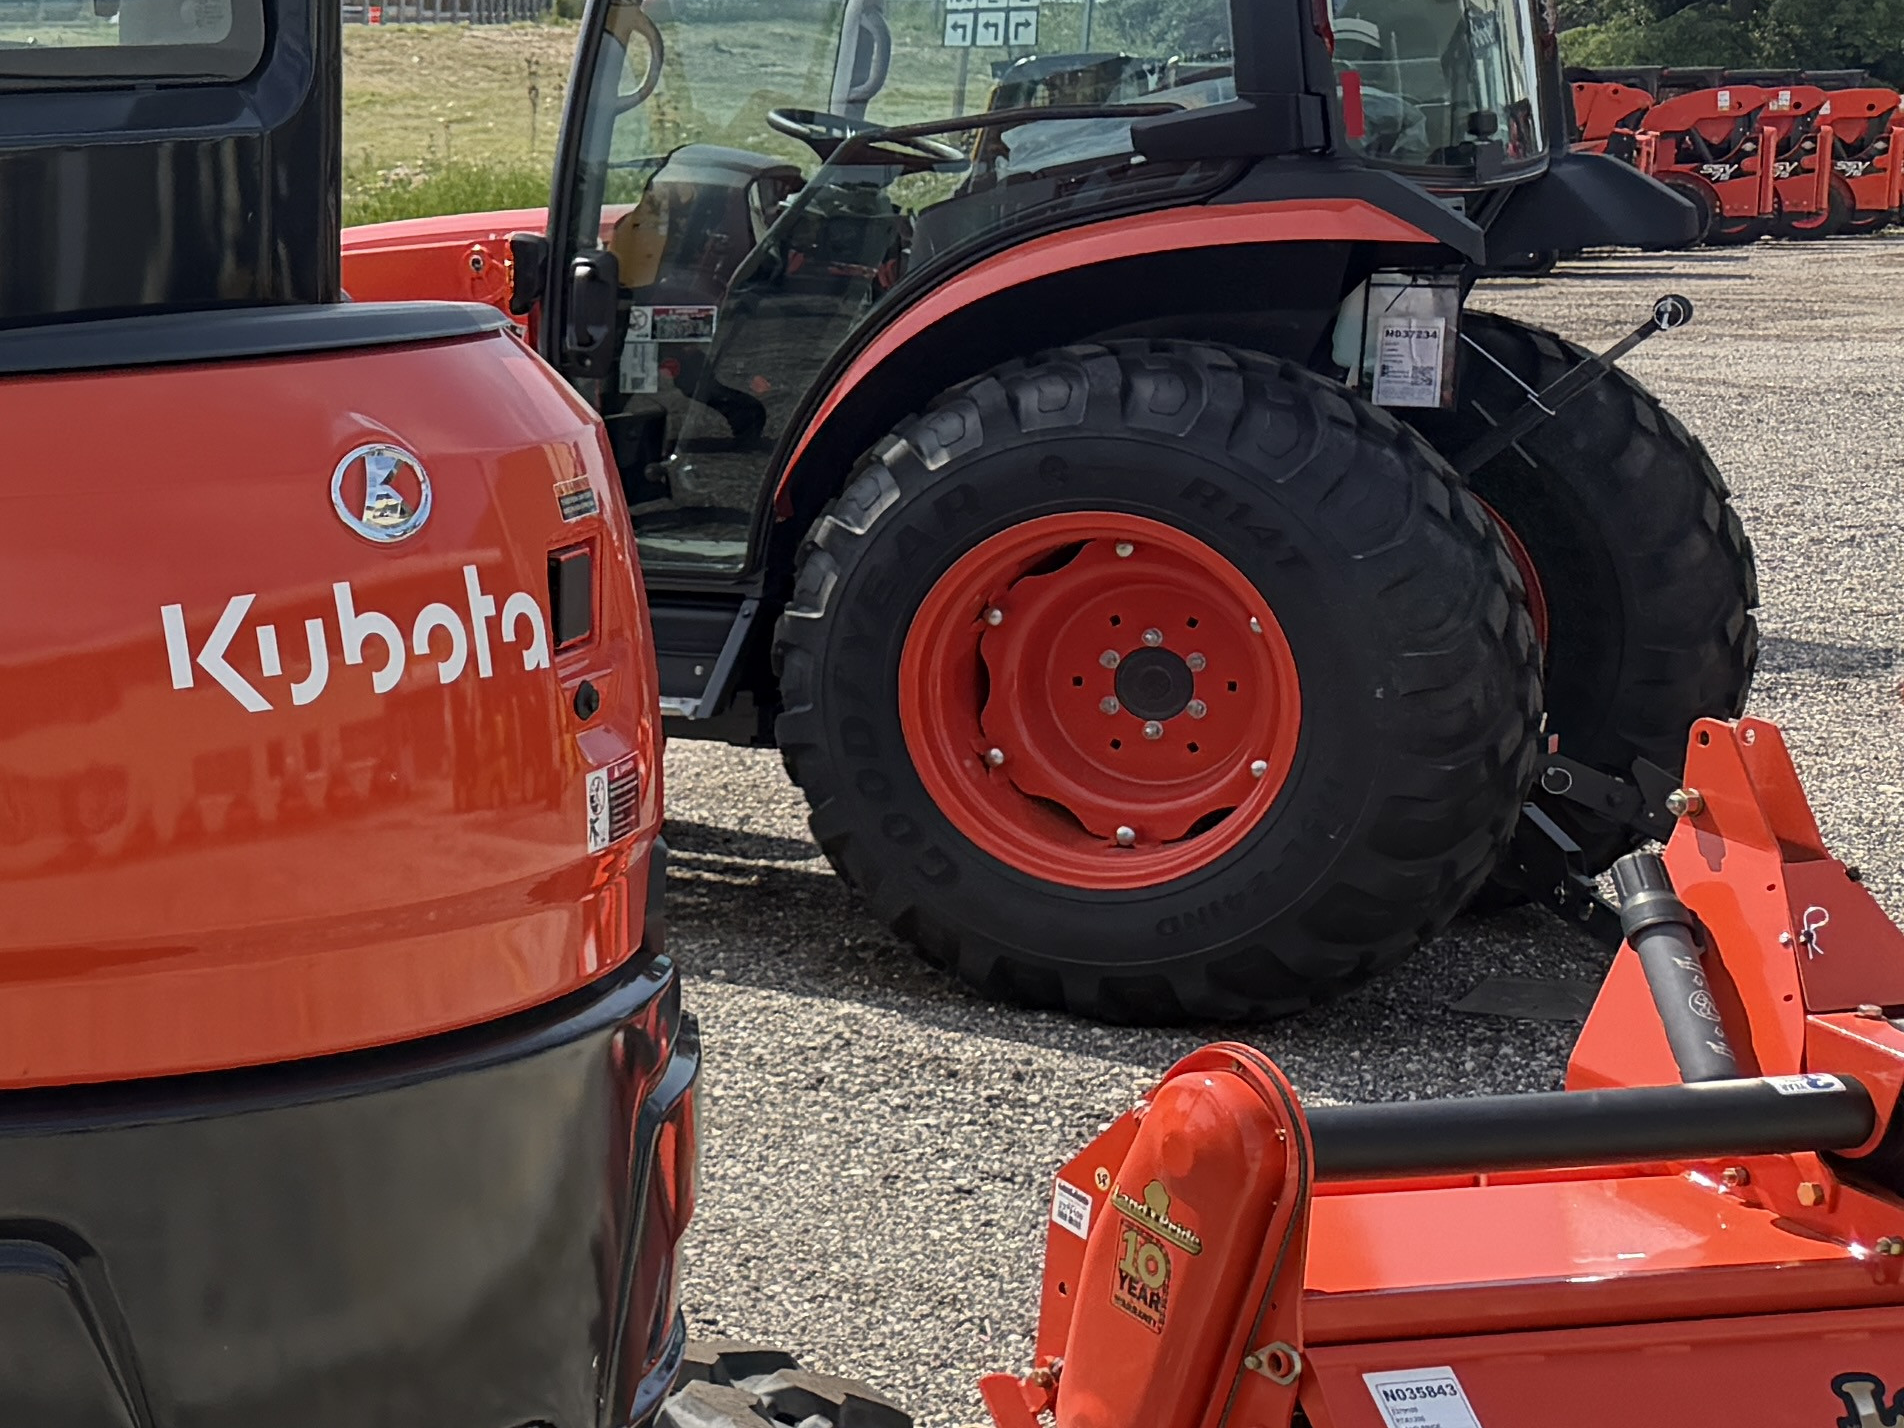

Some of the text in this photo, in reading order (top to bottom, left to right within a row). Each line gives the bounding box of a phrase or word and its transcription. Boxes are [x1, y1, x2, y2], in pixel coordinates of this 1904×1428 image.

[161, 565, 550, 713] Kubota
[1119, 1229, 1167, 1289] 10
[1118, 1271, 1161, 1312] YEAR
[1382, 1383, 1458, 1402] N035843
